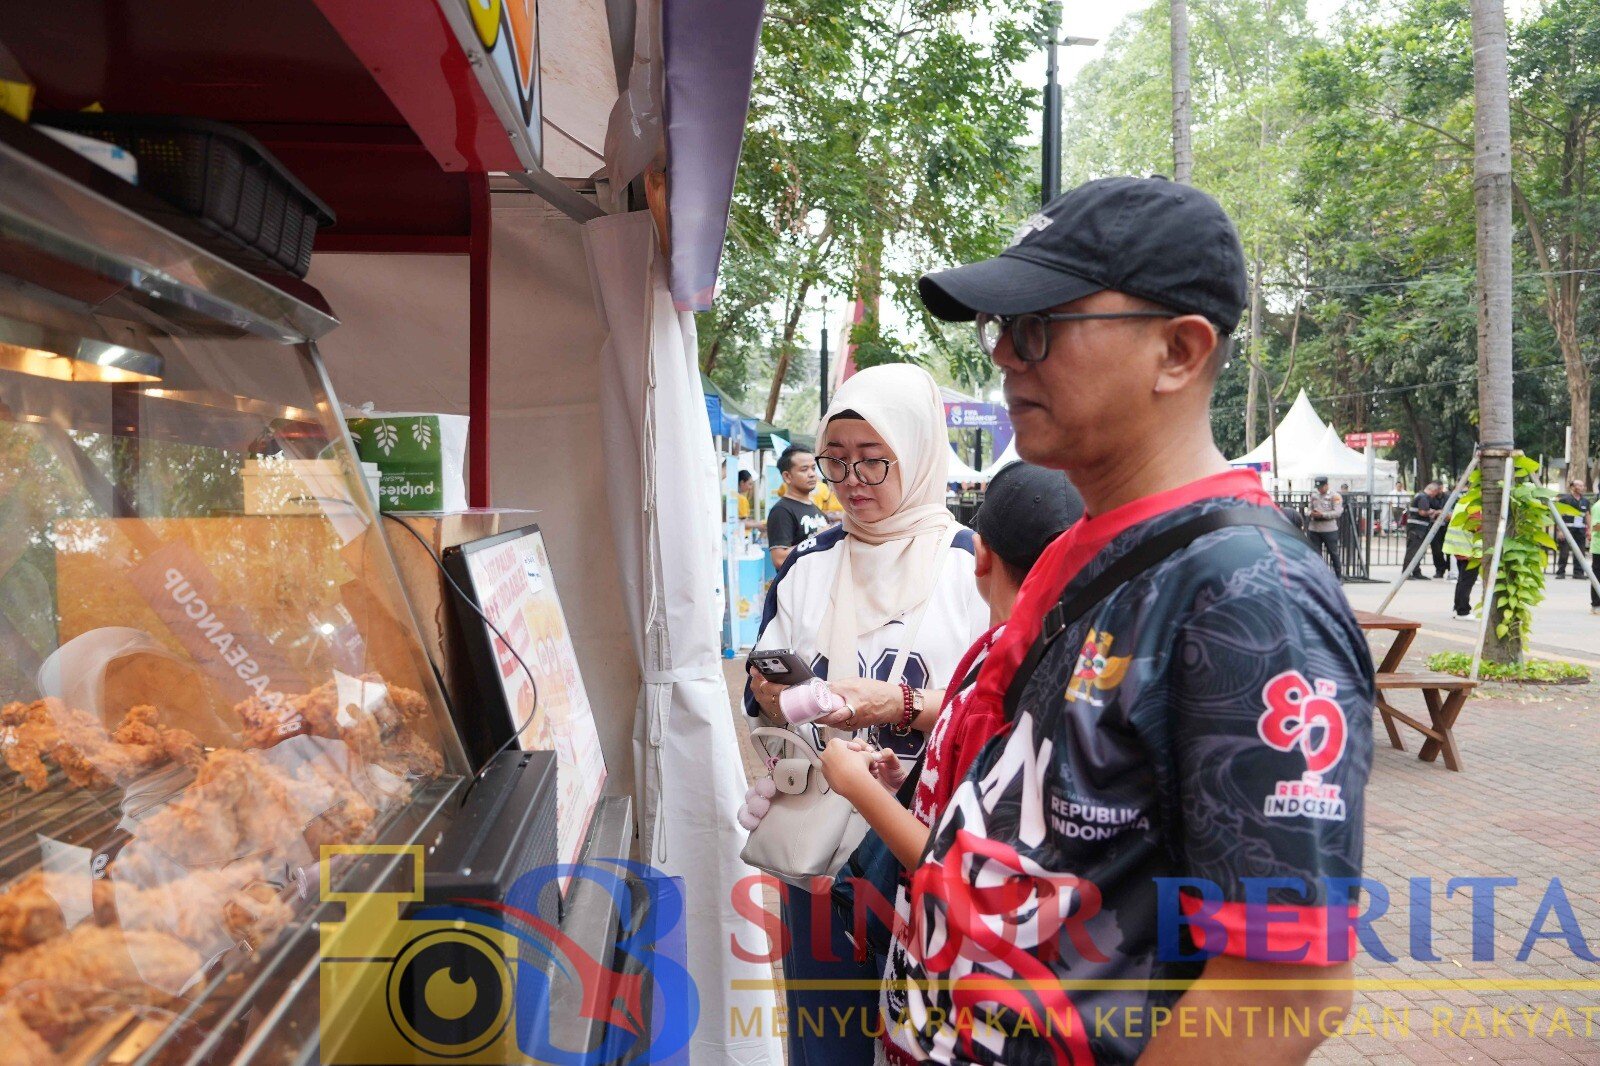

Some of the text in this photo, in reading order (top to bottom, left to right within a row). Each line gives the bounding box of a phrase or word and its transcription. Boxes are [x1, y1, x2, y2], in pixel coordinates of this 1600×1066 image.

[379, 480, 434, 499] pulpies
[1259, 671, 1346, 773] 80
[1050, 794, 1140, 825] REPUBLIK
[1050, 813, 1151, 841] INDONA
